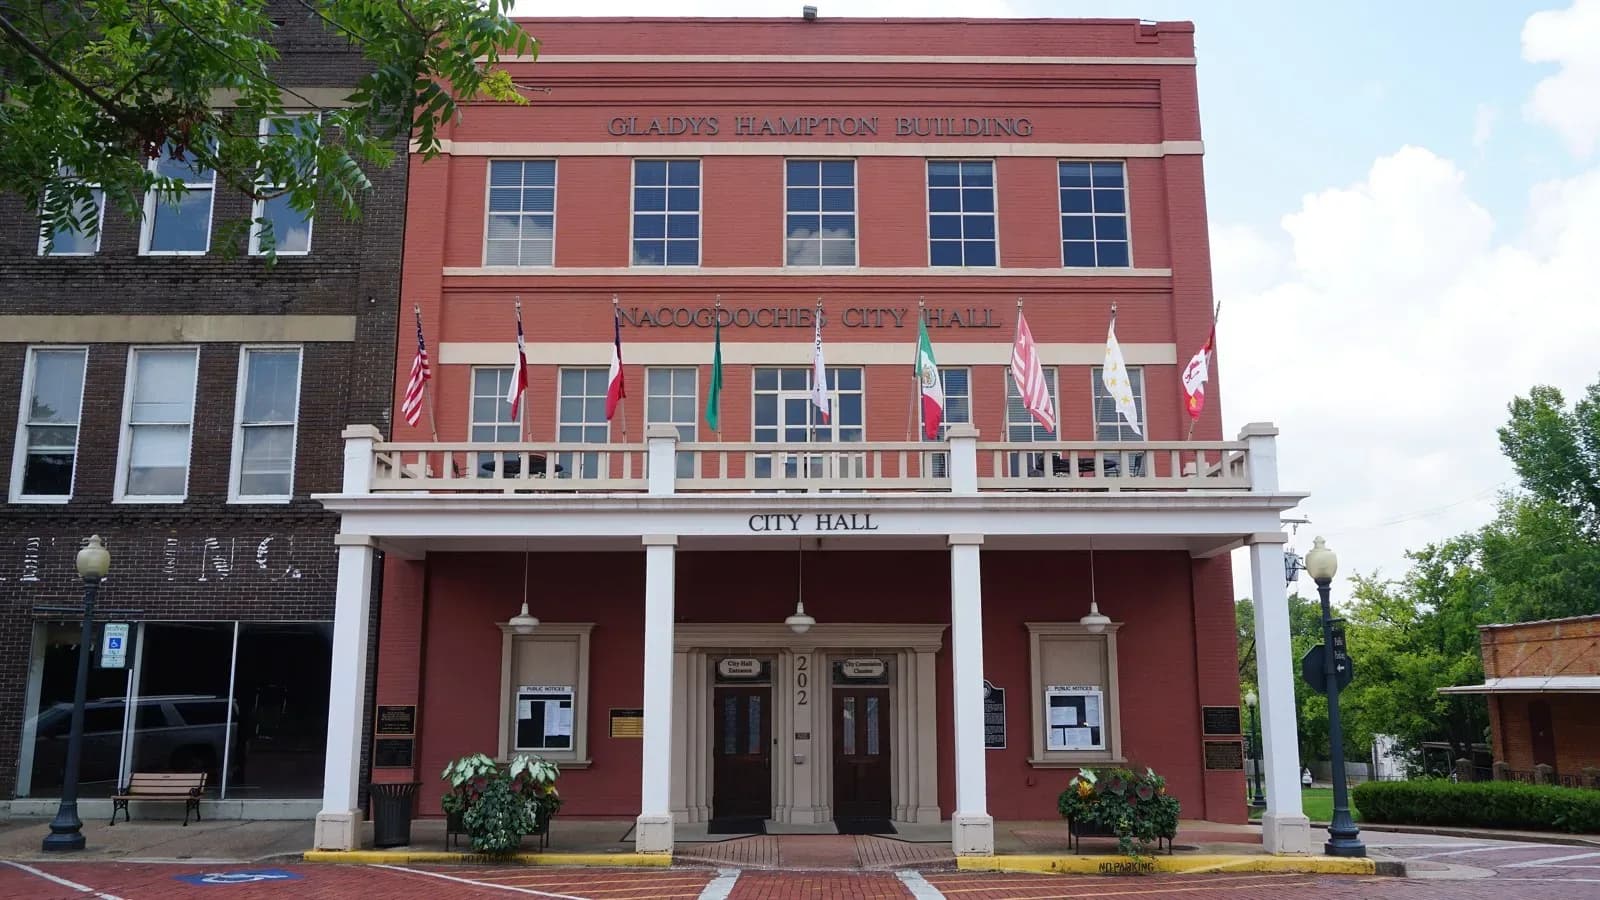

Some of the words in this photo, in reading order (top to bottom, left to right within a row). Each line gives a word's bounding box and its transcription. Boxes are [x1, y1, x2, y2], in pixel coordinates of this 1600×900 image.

[607, 116, 720, 136] GLADYS
[735, 116, 878, 136] HAMPTON
[895, 116, 1033, 137] BUILDING
[618, 306, 828, 328] NACOGDOCHES
[842, 307, 907, 328] CITY
[924, 307, 1002, 328] HALL
[748, 513, 803, 532] CITY
[815, 513, 879, 531] HALL
[797, 656, 808, 706] 202
[1098, 862, 1112, 873] NO
[1113, 862, 1154, 873] PARKING
